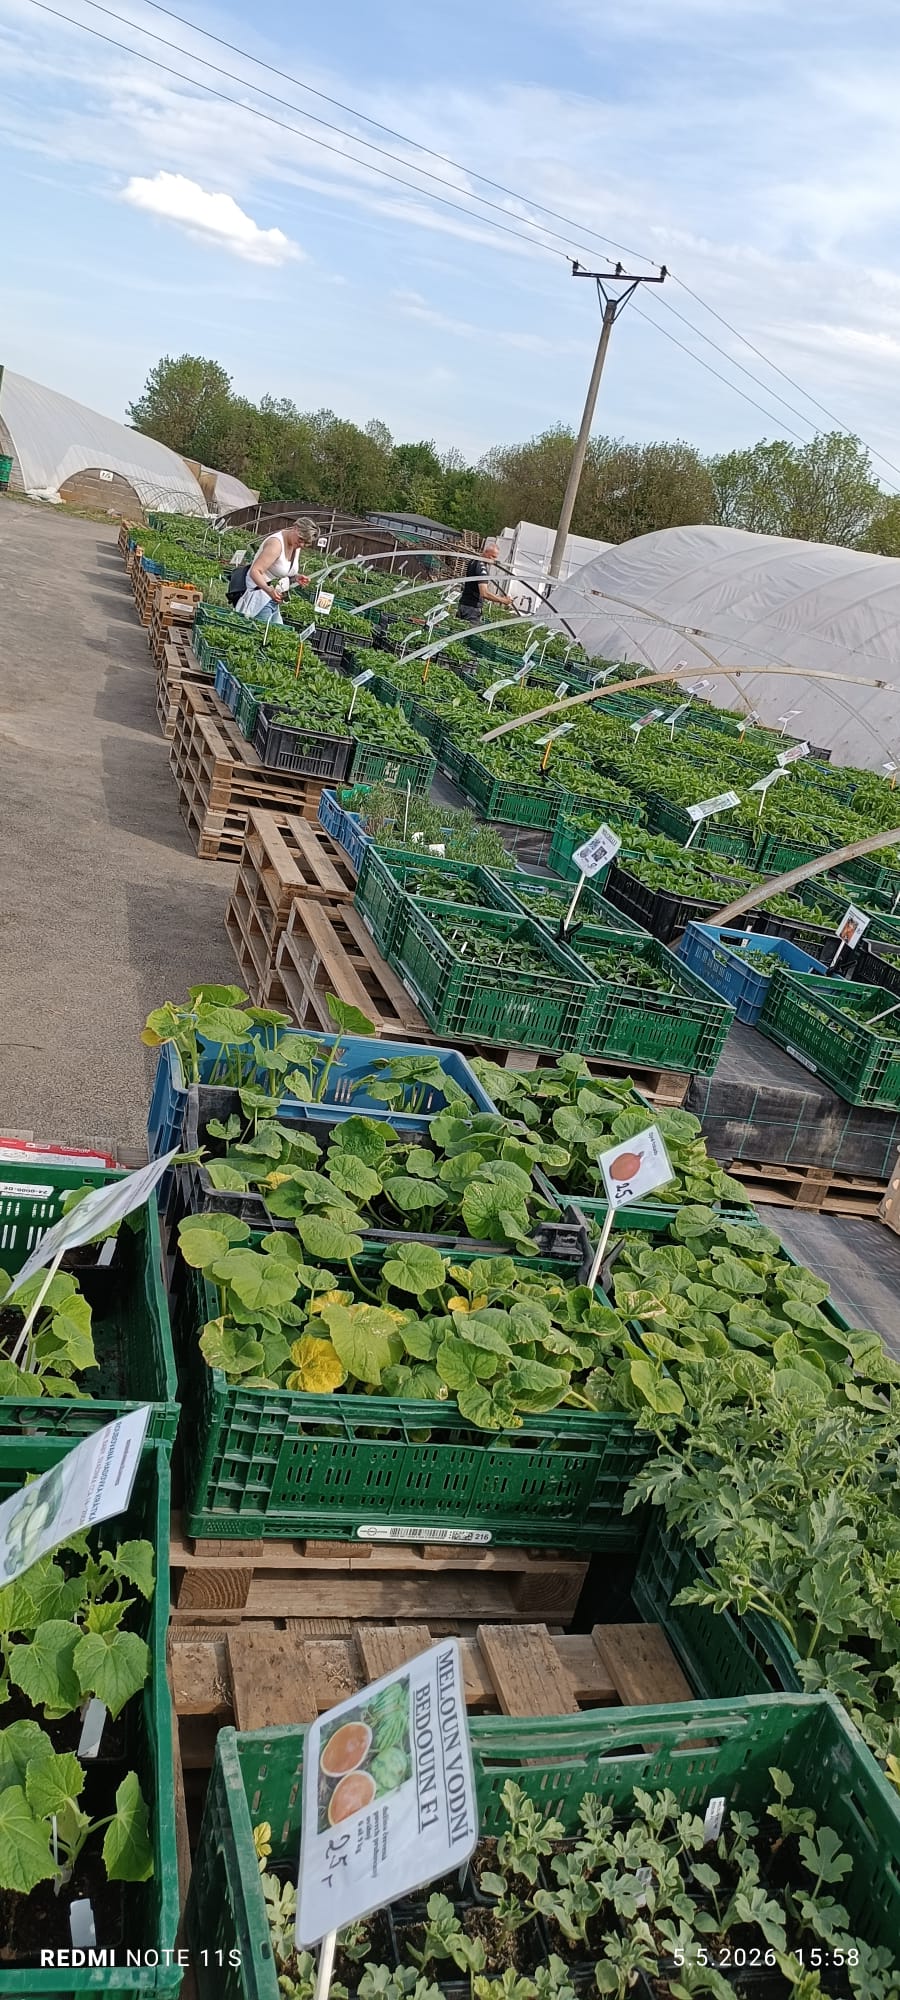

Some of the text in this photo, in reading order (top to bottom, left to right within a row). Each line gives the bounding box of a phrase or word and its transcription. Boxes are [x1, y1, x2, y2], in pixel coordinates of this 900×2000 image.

[615, 1182, 633, 1198] 25
[475, 1533, 489, 1541] 216
[415, 1681, 439, 1831] BEDOUIN F1
[439, 1648, 473, 1845] MELOUN VODNÍ
